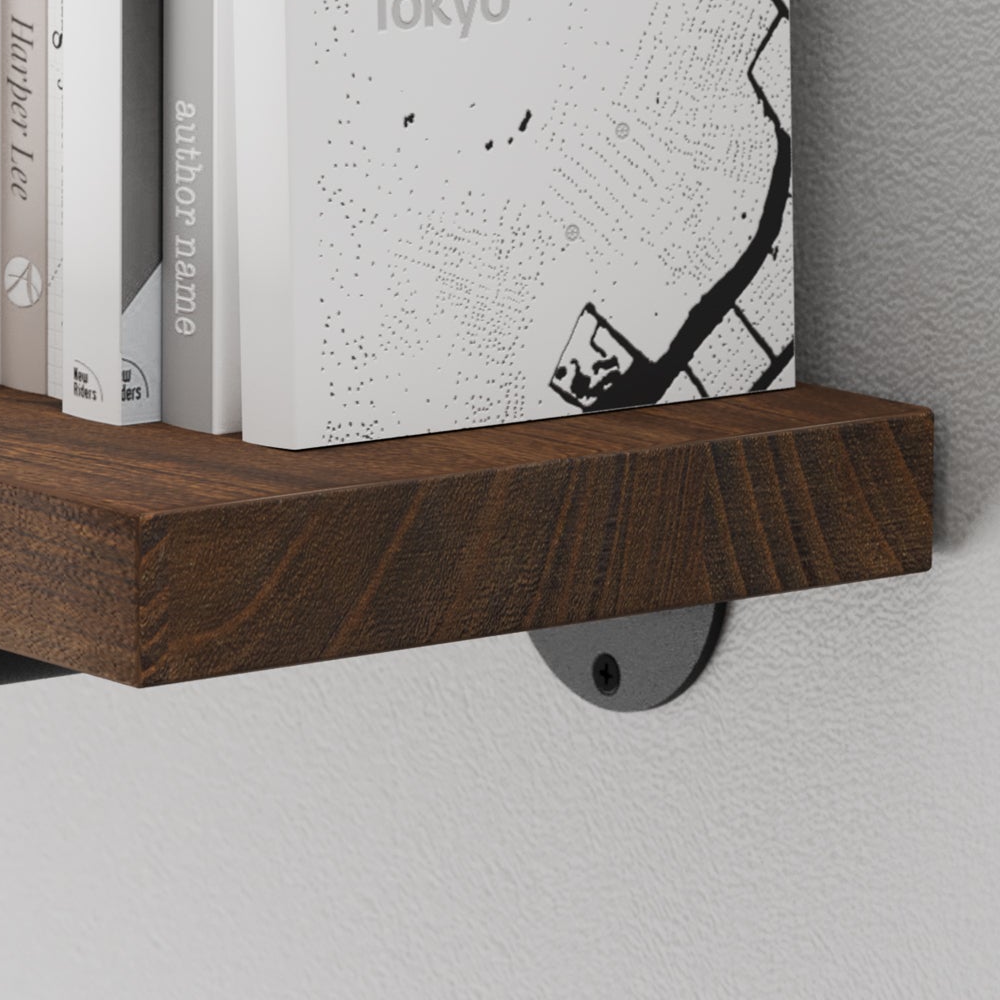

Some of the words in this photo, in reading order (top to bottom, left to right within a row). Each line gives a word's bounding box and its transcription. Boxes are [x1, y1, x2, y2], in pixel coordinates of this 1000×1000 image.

[6, 15, 36, 138] Harper
[10, 143, 35, 202] Lee
[174, 99, 202, 227] author
[174, 236, 198, 337] name
[73, 366, 89, 385] New
[73, 382, 98, 402] Riders
[121, 384, 142, 402] ders
